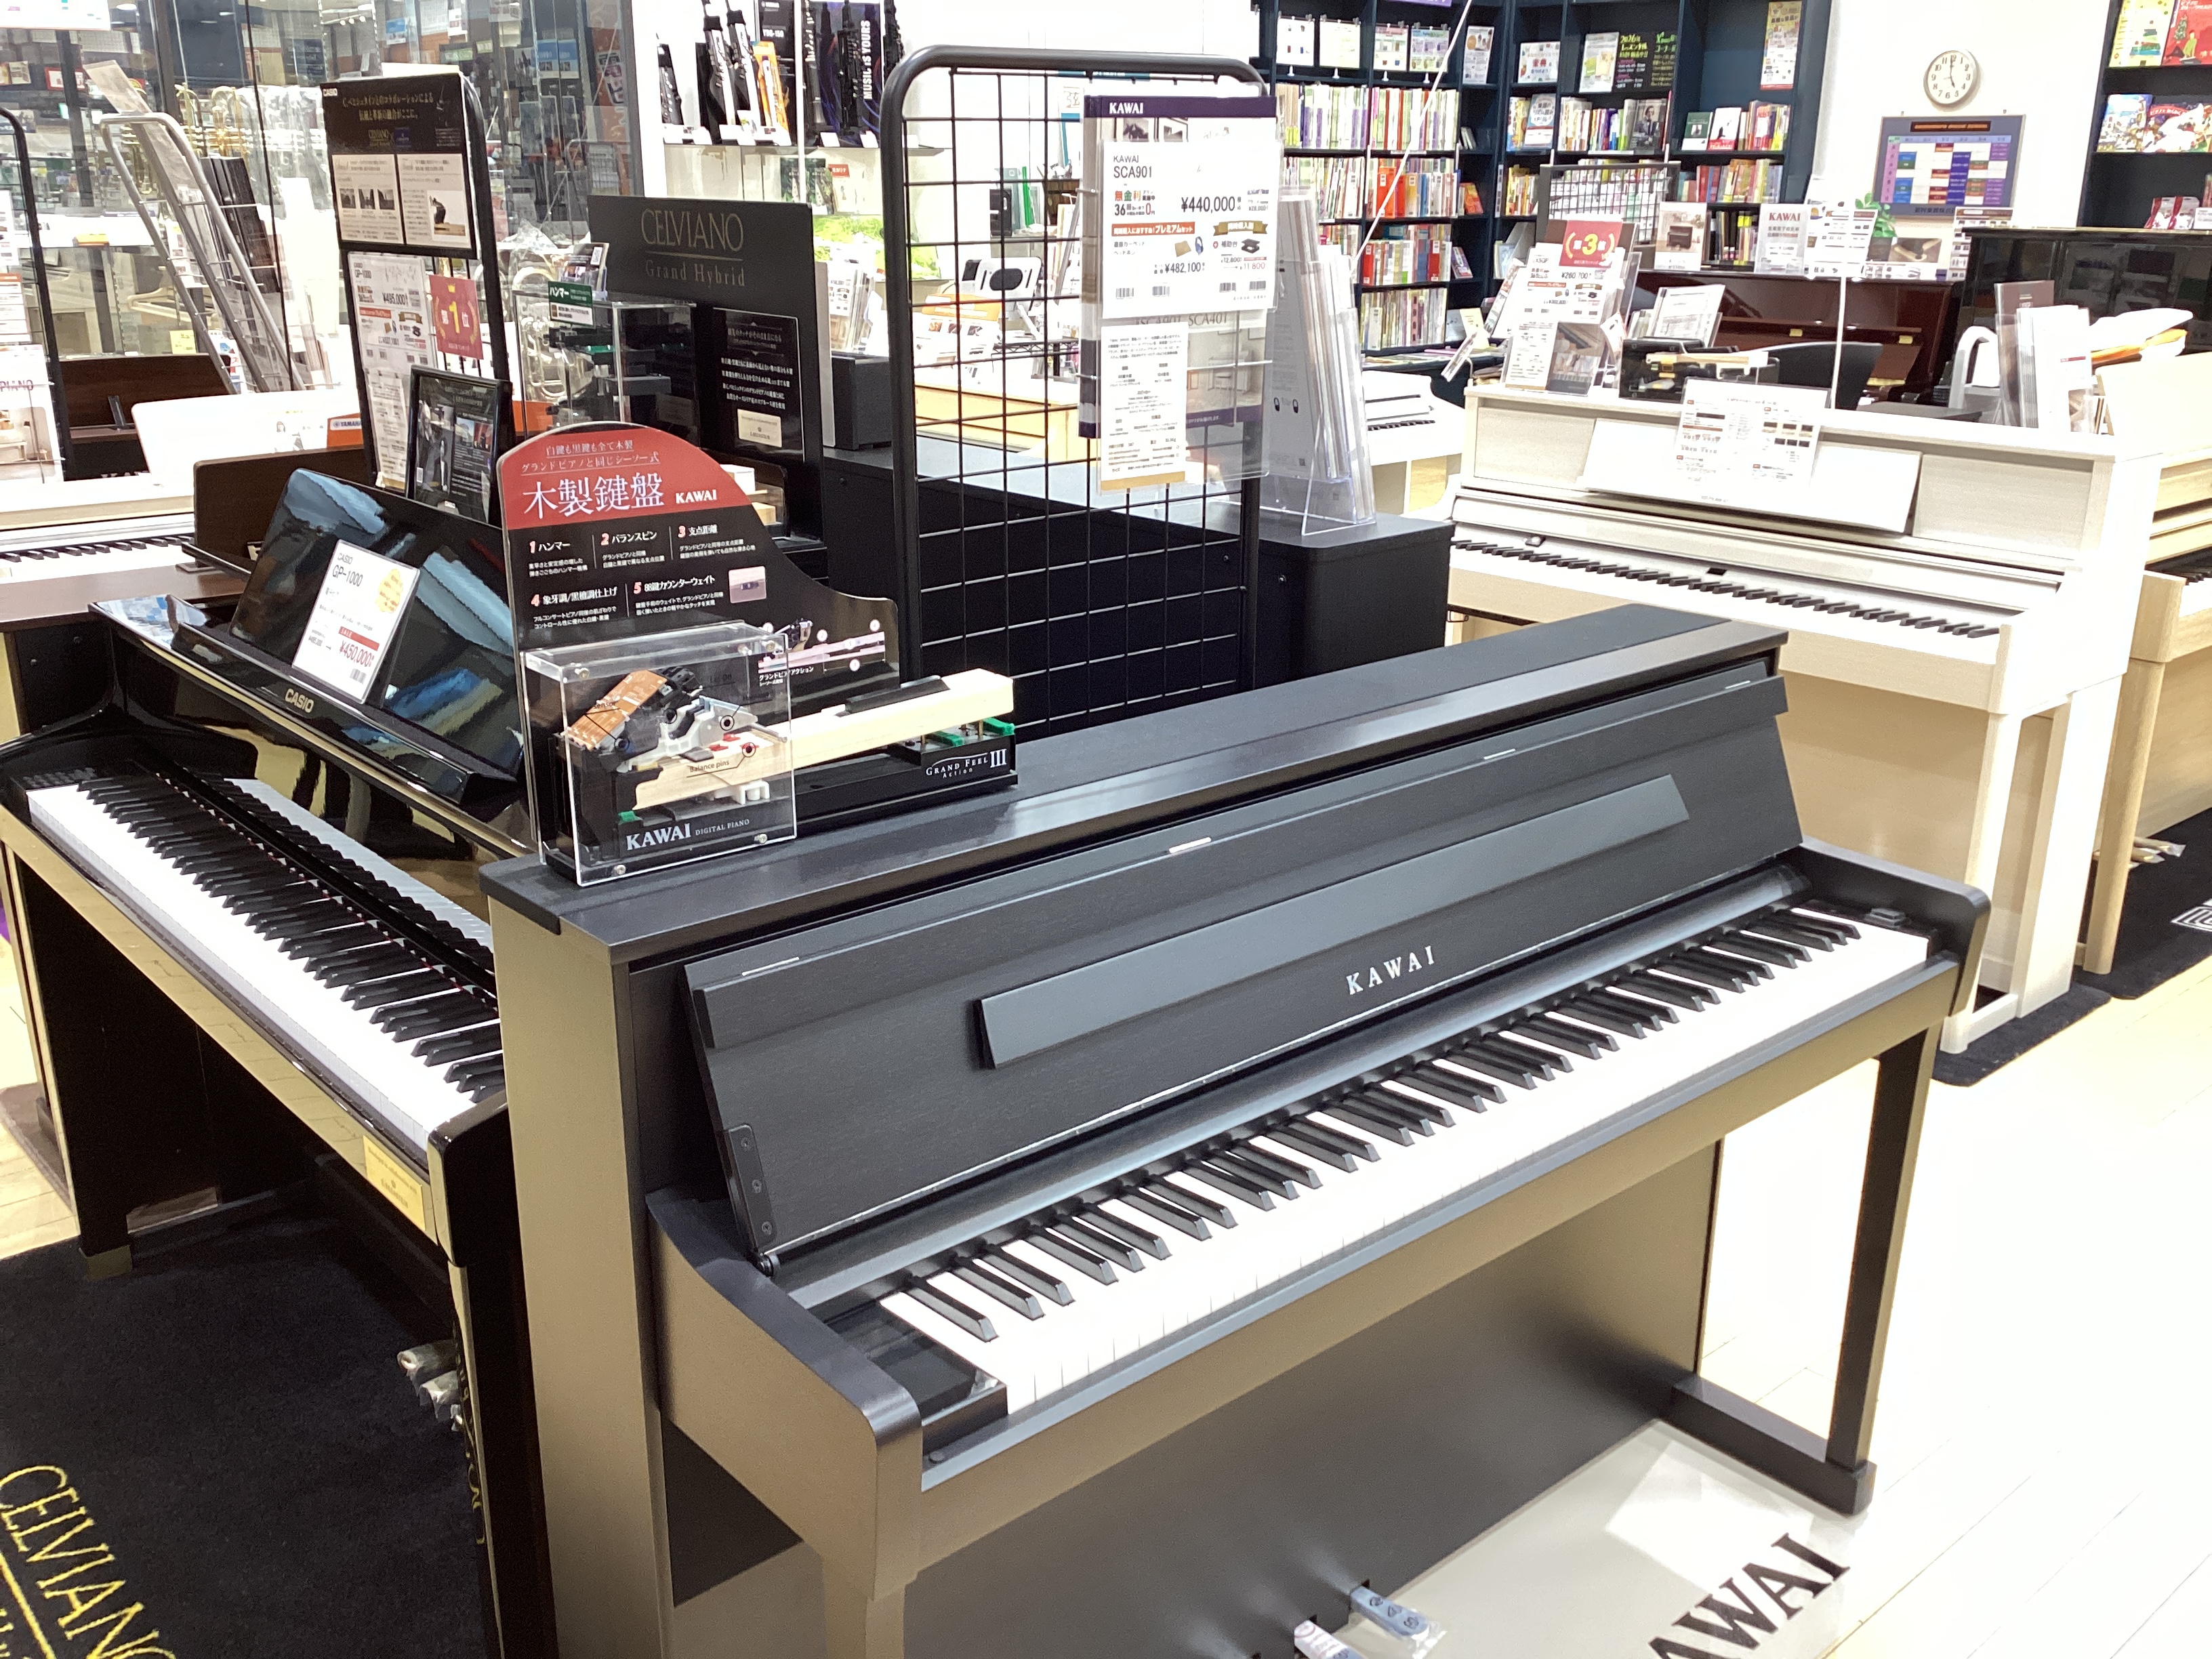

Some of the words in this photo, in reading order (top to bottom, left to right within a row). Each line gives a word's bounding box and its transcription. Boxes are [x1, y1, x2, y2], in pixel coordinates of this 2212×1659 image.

[861, 20, 871, 54] YOURS
[1109, 102, 1144, 114] KAWAI
[1113, 155, 1139, 163] KAWAI
[1113, 166, 1152, 178] SCA901
[1181, 197, 1235, 213] ¥440,000
[1769, 212, 1801, 221] KAWAI
[641, 209, 743, 251] CELVIANO
[646, 260, 687, 281] Grand
[694, 263, 745, 288] Hybrid
[546, 440, 633, 456] 白鍵も黒鍵も全て木製
[522, 451, 659, 473] グランドピアノと同じシーソー式
[523, 472, 665, 520] 木製鍵盤
[676, 489, 717, 504] KAWAI
[600, 533, 609, 546] 2
[678, 525, 686, 538] 3
[529, 541, 536, 554] 1
[538, 541, 571, 552] ハンマー
[337, 553, 353, 565] CASIO
[332, 565, 363, 588] GP-1000
[633, 581, 642, 594] 5
[531, 594, 540, 607] 4
[285, 688, 314, 713] CASIO
[689, 763, 715, 773] Balance
[716, 759, 730, 769] pins
[926, 763, 960, 776] GRAND
[990, 748, 1007, 768] III
[943, 767, 973, 779] Action
[626, 823, 691, 851] KAWAI
[695, 823, 726, 836] DIGITAL
[727, 819, 750, 830] PIANO
[1346, 945, 1435, 996] KAWAI
[0, 1465, 178, 1659] CELVIAN
